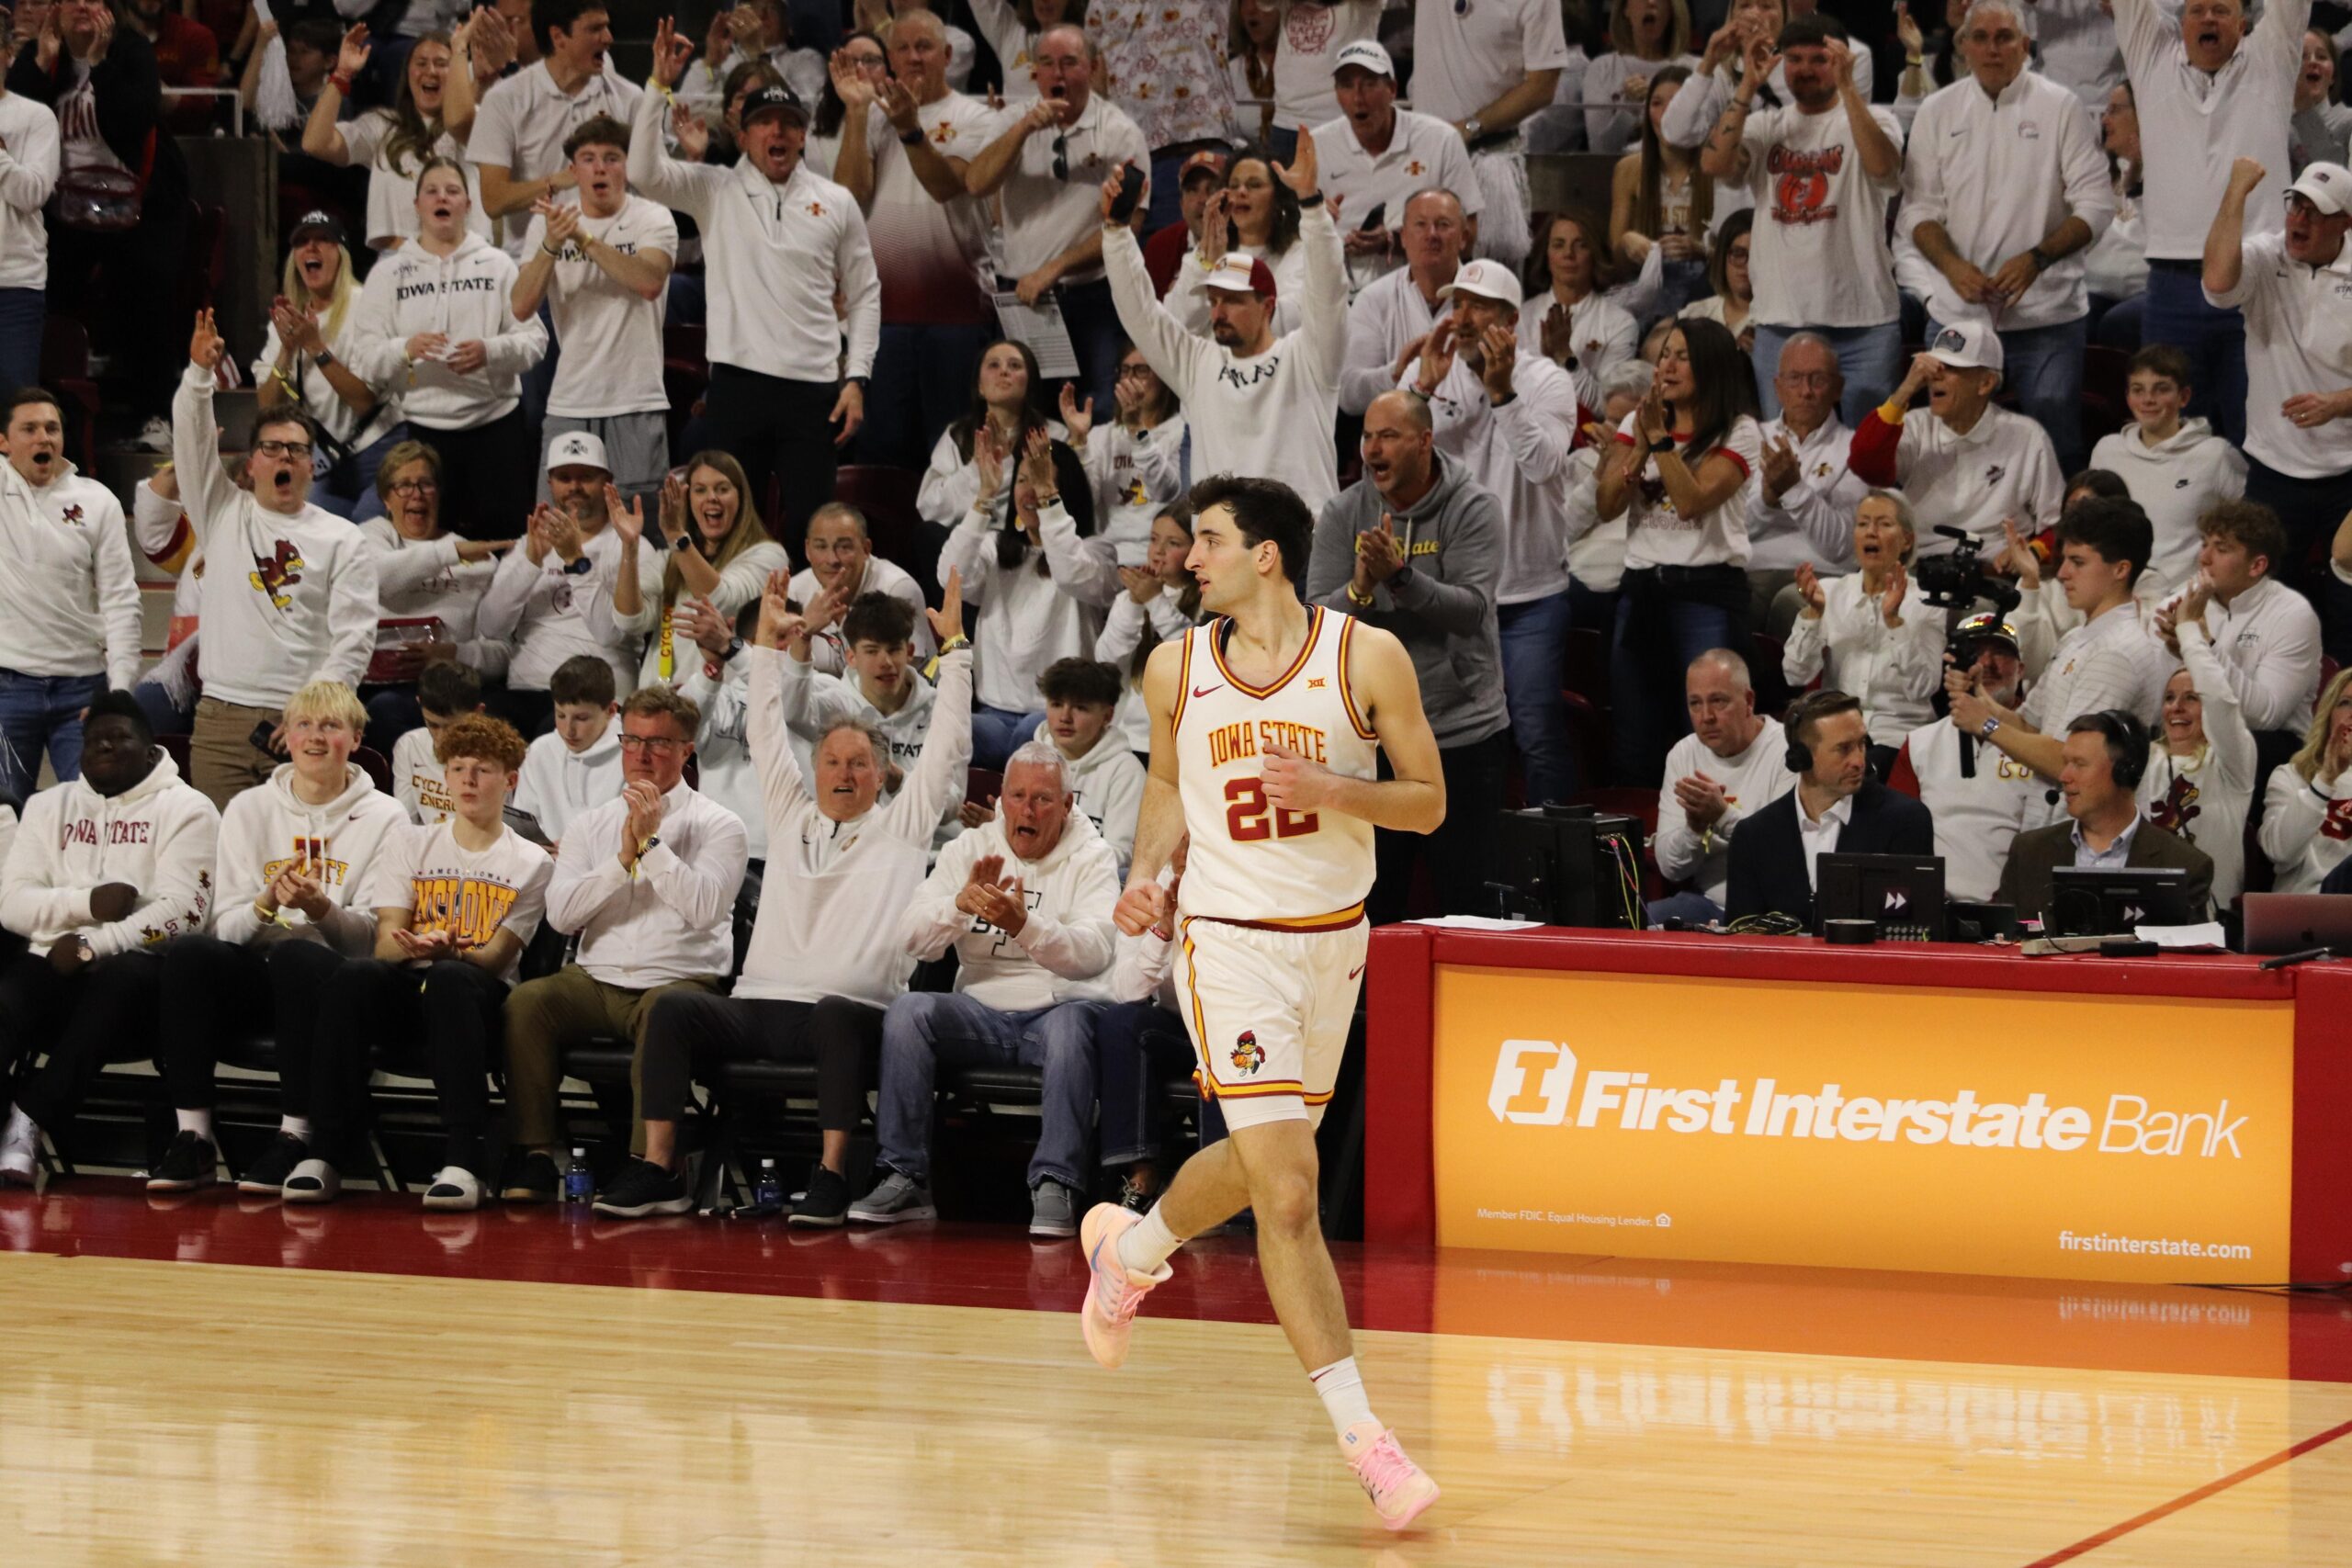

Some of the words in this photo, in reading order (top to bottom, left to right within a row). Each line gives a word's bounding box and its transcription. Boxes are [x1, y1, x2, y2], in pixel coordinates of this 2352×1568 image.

[1394, 536, 1442, 558] Sate
[1208, 720, 1257, 768] IOWA
[1260, 719, 1328, 765] STATE
[104, 819, 151, 844] TATE
[1577, 1070, 1742, 1134] First
[1744, 1077, 2091, 1151] Interstate
[2098, 1093, 2248, 1159] Bank
[1476, 1208, 1518, 1220] Member
[1519, 1210, 1545, 1221] FDIC.
[1547, 1211, 1575, 1224] Equal
[1577, 1213, 1616, 1227] Housing
[1618, 1215, 1653, 1227] Lender.
[2058, 1229, 2251, 1259] firstinterstate.com
